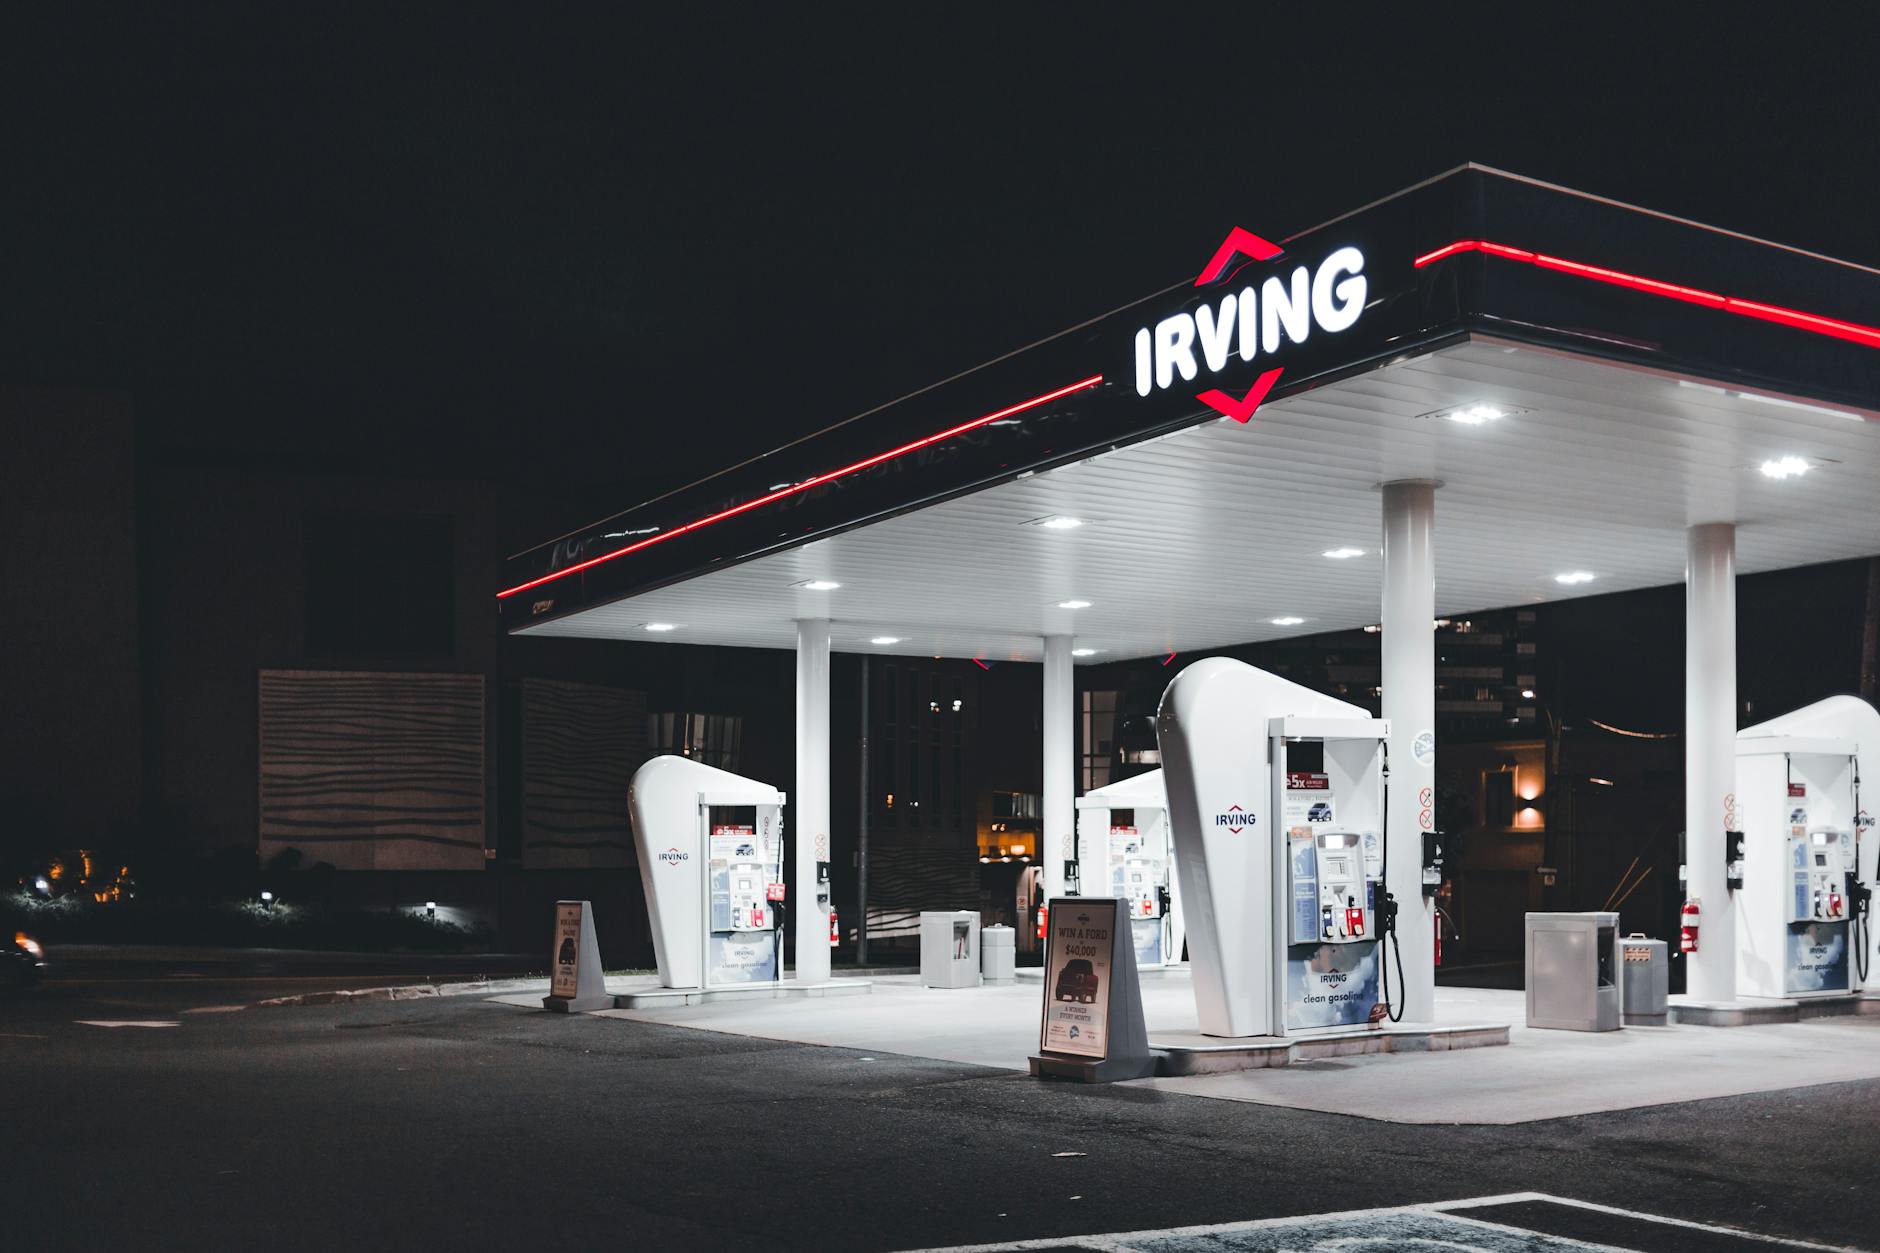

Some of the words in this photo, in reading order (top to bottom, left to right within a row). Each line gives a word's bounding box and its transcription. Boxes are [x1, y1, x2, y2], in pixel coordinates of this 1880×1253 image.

[1135, 246, 1368, 398] IRVING
[1216, 814, 1256, 826] IRVING
[658, 852, 689, 861] IRVING
[1058, 928, 1076, 938] WIN
[1077, 928, 1084, 939] A
[1085, 929, 1108, 940] FORD
[1065, 944, 1097, 957] $40,000
[1798, 962, 1814, 971] clean
[1320, 974, 1347, 984] IRVING
[1303, 993, 1325, 1004] clean
[1328, 991, 1364, 1004] gasoline
